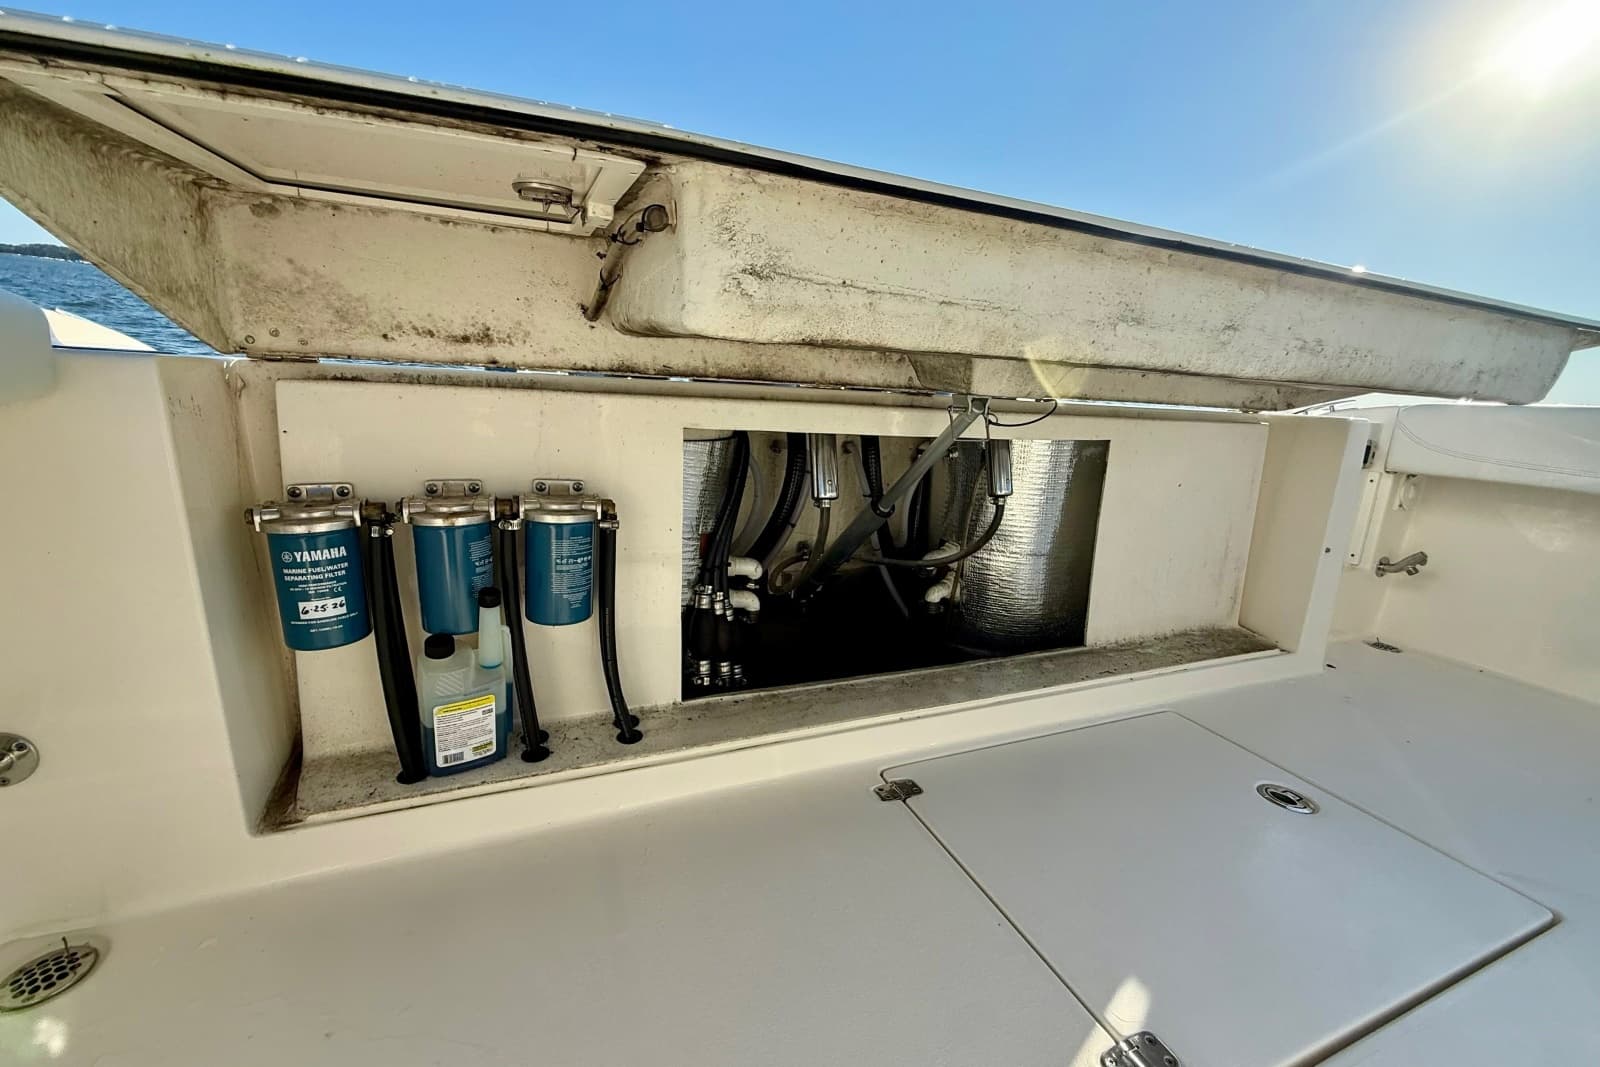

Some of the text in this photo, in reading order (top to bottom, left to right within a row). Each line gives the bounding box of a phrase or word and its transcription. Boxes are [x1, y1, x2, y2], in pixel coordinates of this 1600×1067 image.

[293, 546, 347, 562] YAMAHA
[308, 562, 349, 573] FUEL/WATER
[324, 570, 346, 579] FILTER
